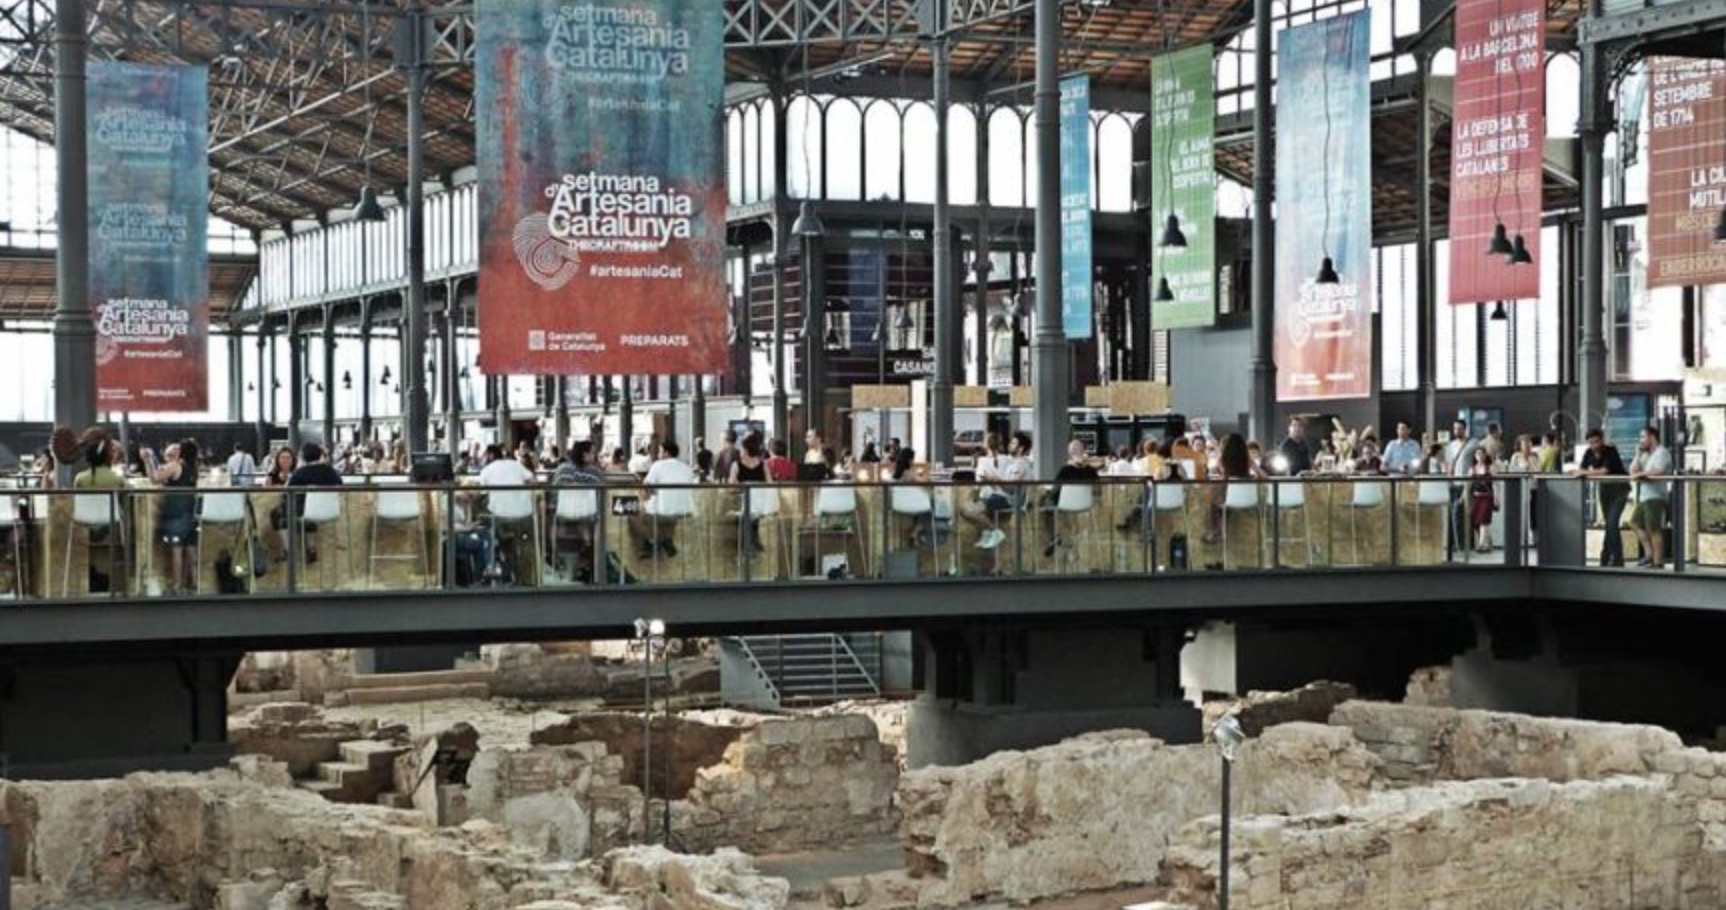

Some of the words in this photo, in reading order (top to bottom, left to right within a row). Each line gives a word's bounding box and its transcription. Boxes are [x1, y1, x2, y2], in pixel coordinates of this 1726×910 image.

[561, 3, 657, 26] setmana
[1468, 43, 1480, 60] LA
[545, 42, 688, 82] Catalunya
[1654, 81, 1713, 107] SETEMBRE
[1654, 110, 1668, 129] DE
[1457, 122, 1469, 140] LA
[1456, 142, 1473, 160] LES
[563, 171, 659, 194] setmana
[1691, 168, 1706, 187] LA
[547, 210, 692, 248] Catalunya
[589, 264, 684, 279] #artesaniaCat
[99, 319, 188, 341] Catalunya
[620, 334, 689, 348] PREPARATS
